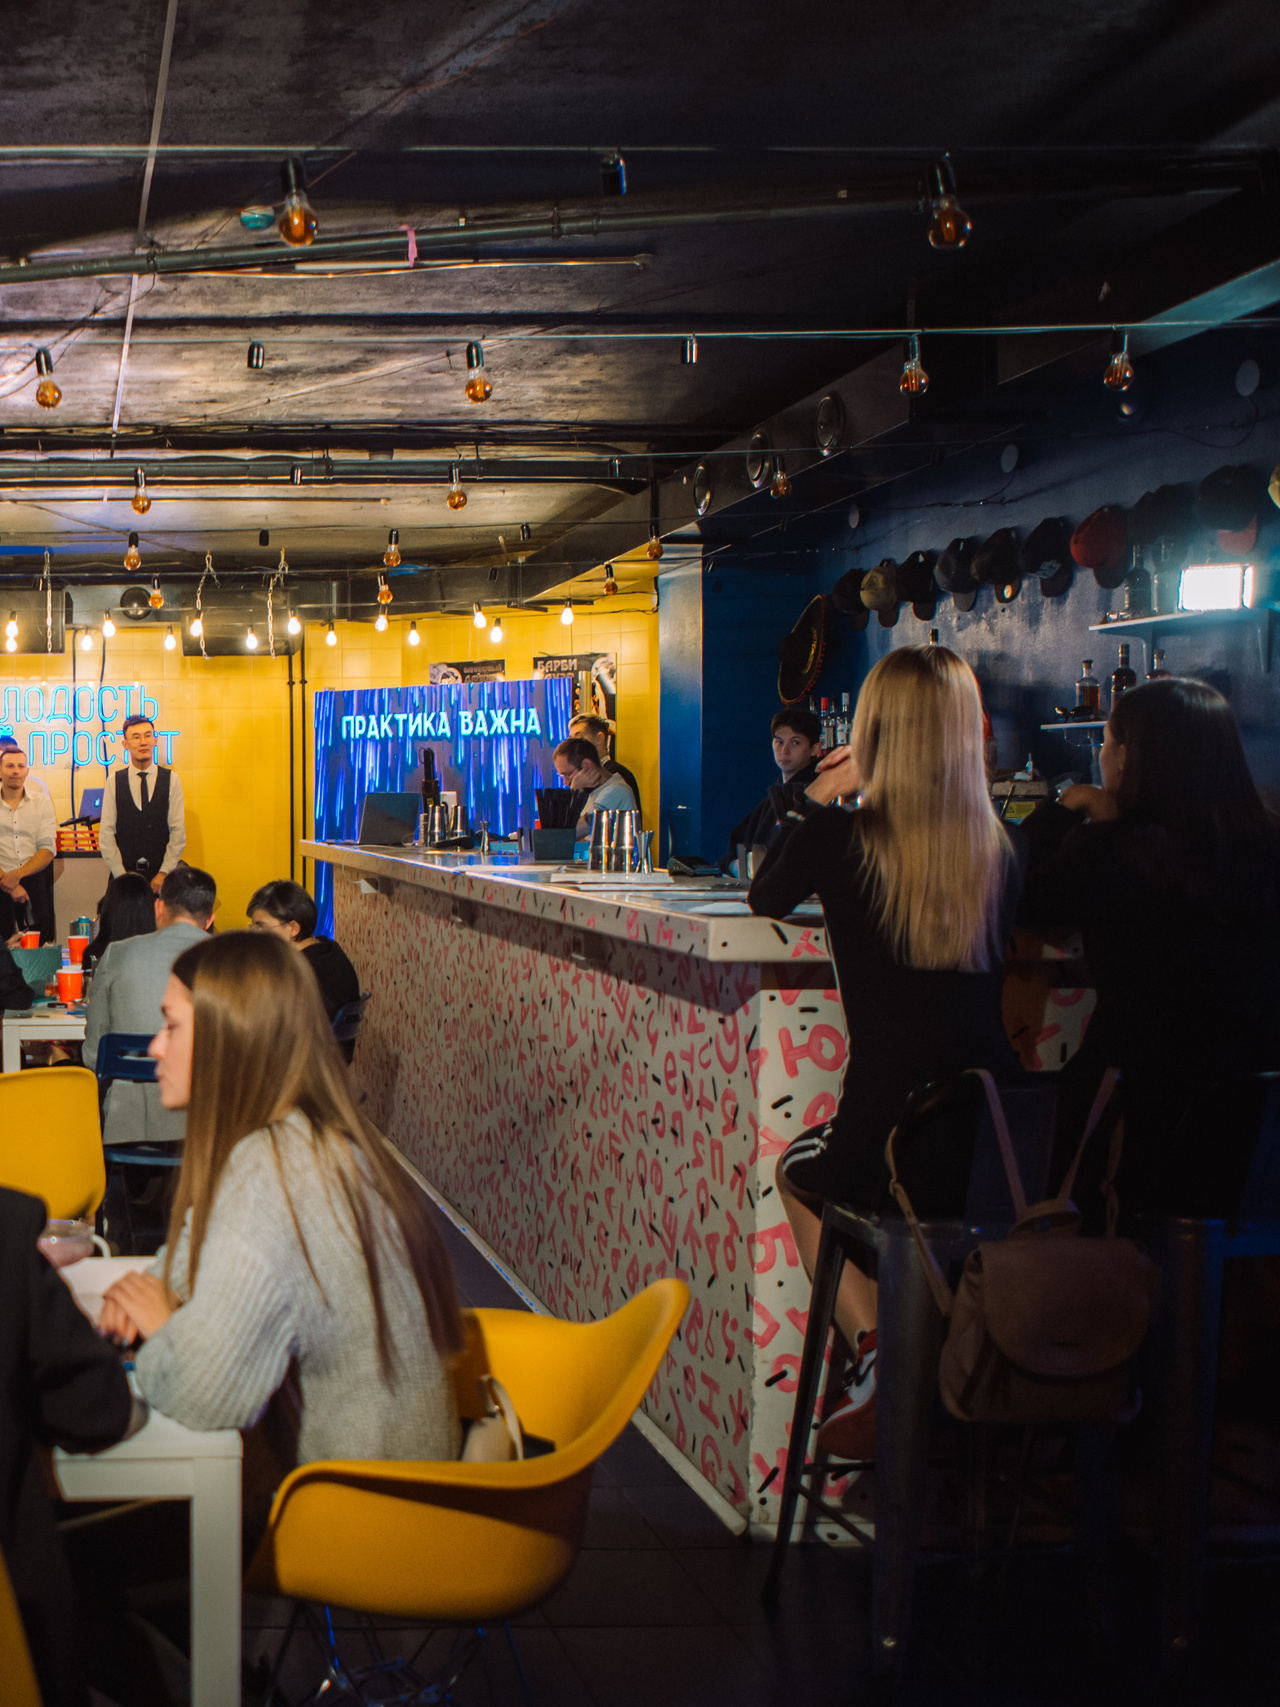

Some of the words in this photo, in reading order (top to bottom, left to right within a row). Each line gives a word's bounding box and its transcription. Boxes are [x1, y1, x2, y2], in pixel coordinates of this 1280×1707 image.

[537, 658, 577, 672] БАРБИ
[341, 712, 451, 740] ПРАКТИКА
[458, 707, 541, 736] ВАЖНА
[29, 730, 180, 766] ПРОСТ
